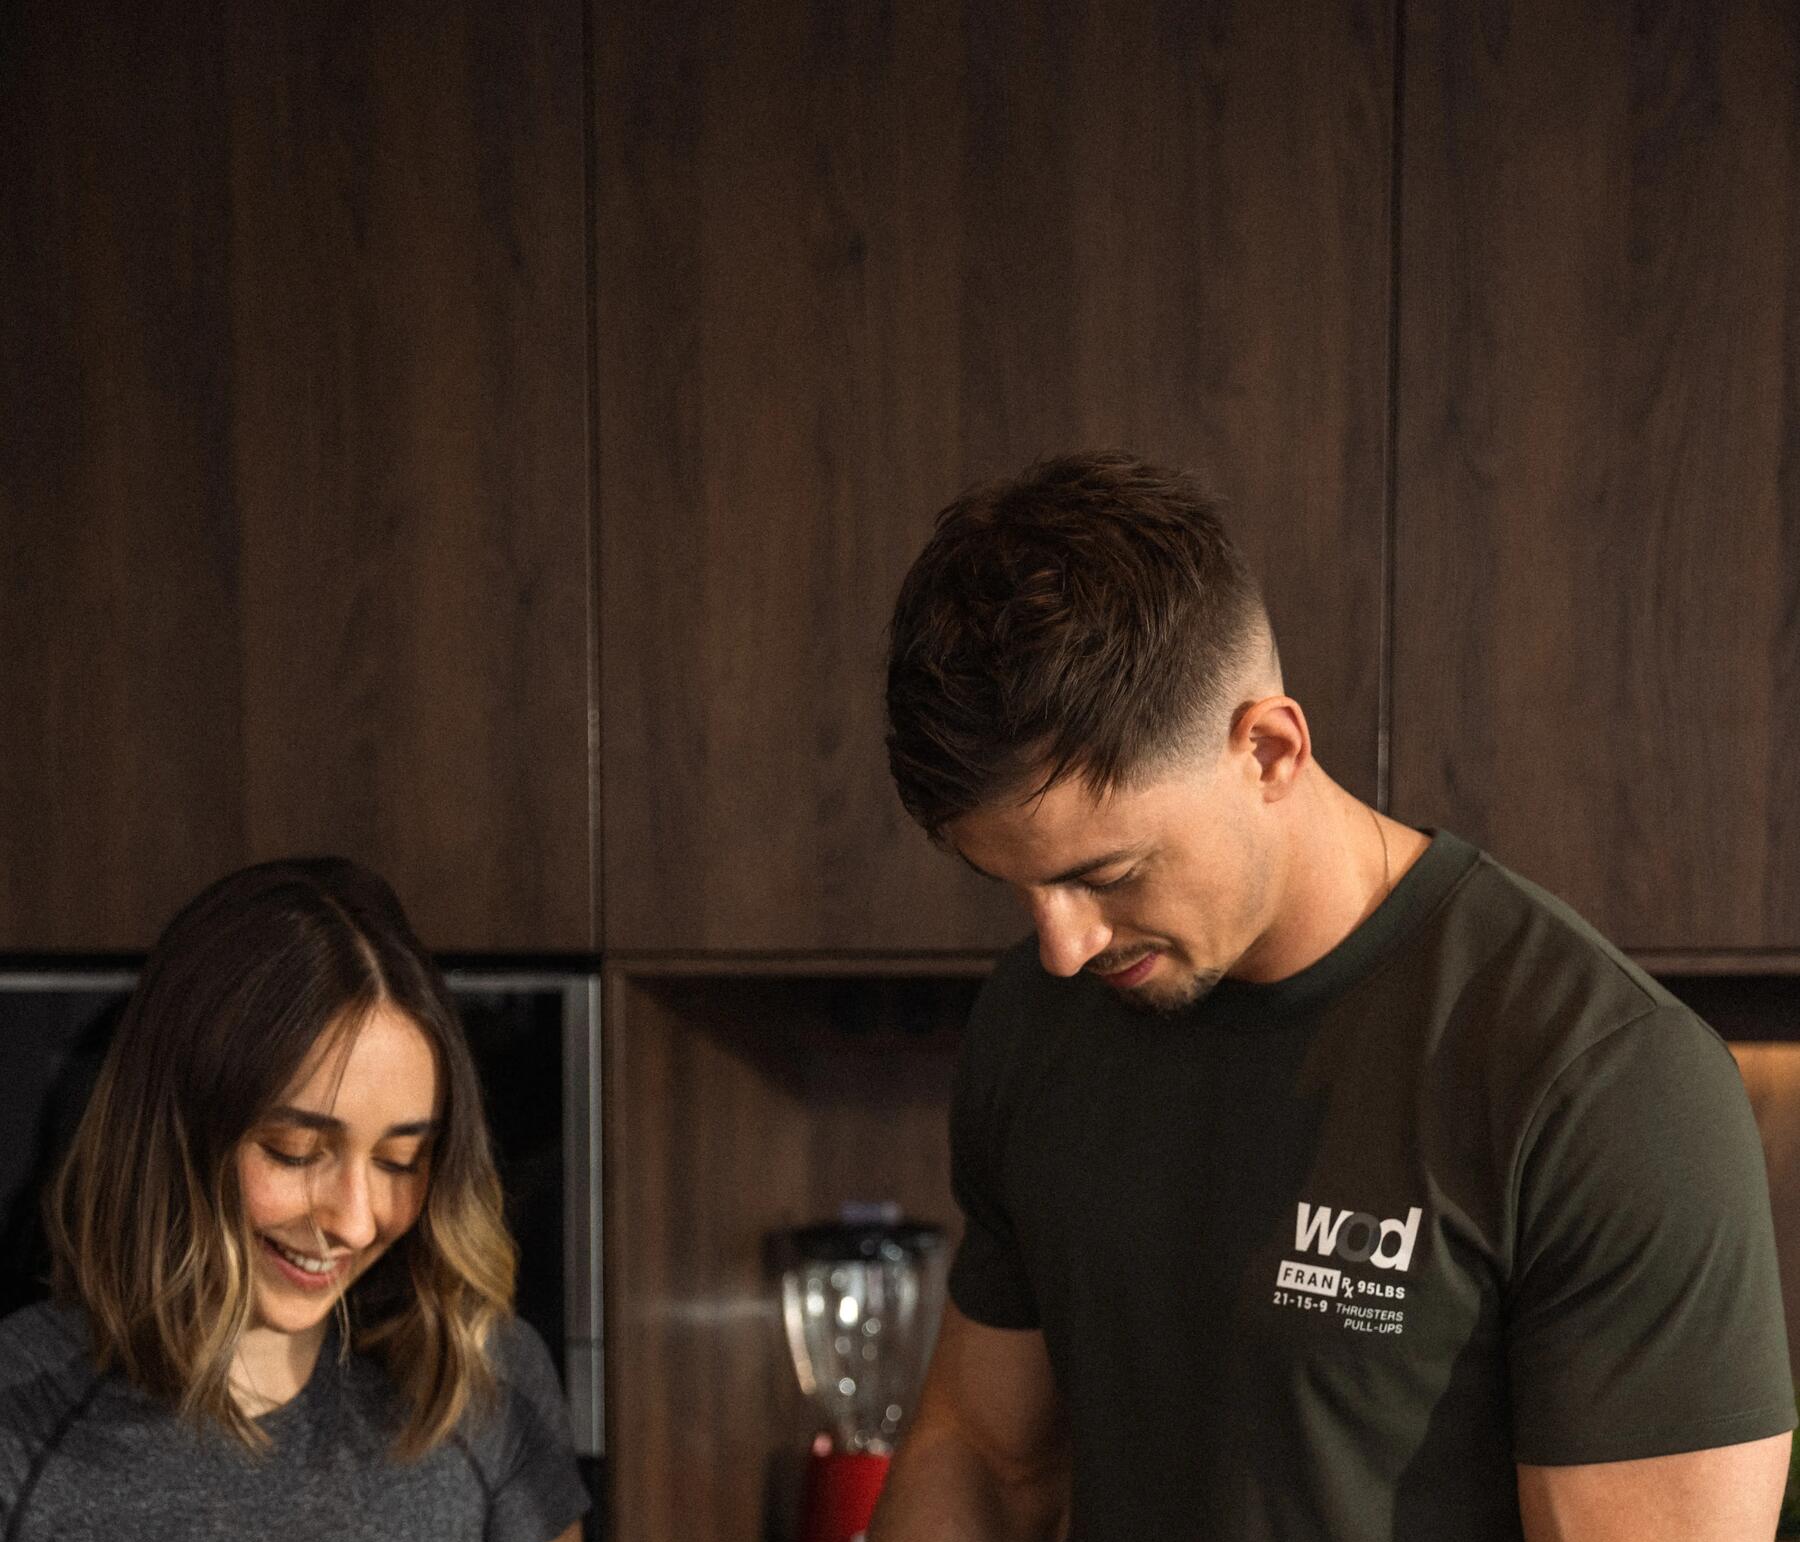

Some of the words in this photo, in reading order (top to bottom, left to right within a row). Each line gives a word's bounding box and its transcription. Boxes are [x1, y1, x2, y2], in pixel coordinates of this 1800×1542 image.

[1283, 1267, 1334, 1290] FRAN
[1357, 1280, 1406, 1300] 95LBS
[1273, 1291, 1328, 1313] 21-15-9
[1335, 1302, 1404, 1322] THRUSTERS
[1344, 1318, 1403, 1335] PULL-UPS
